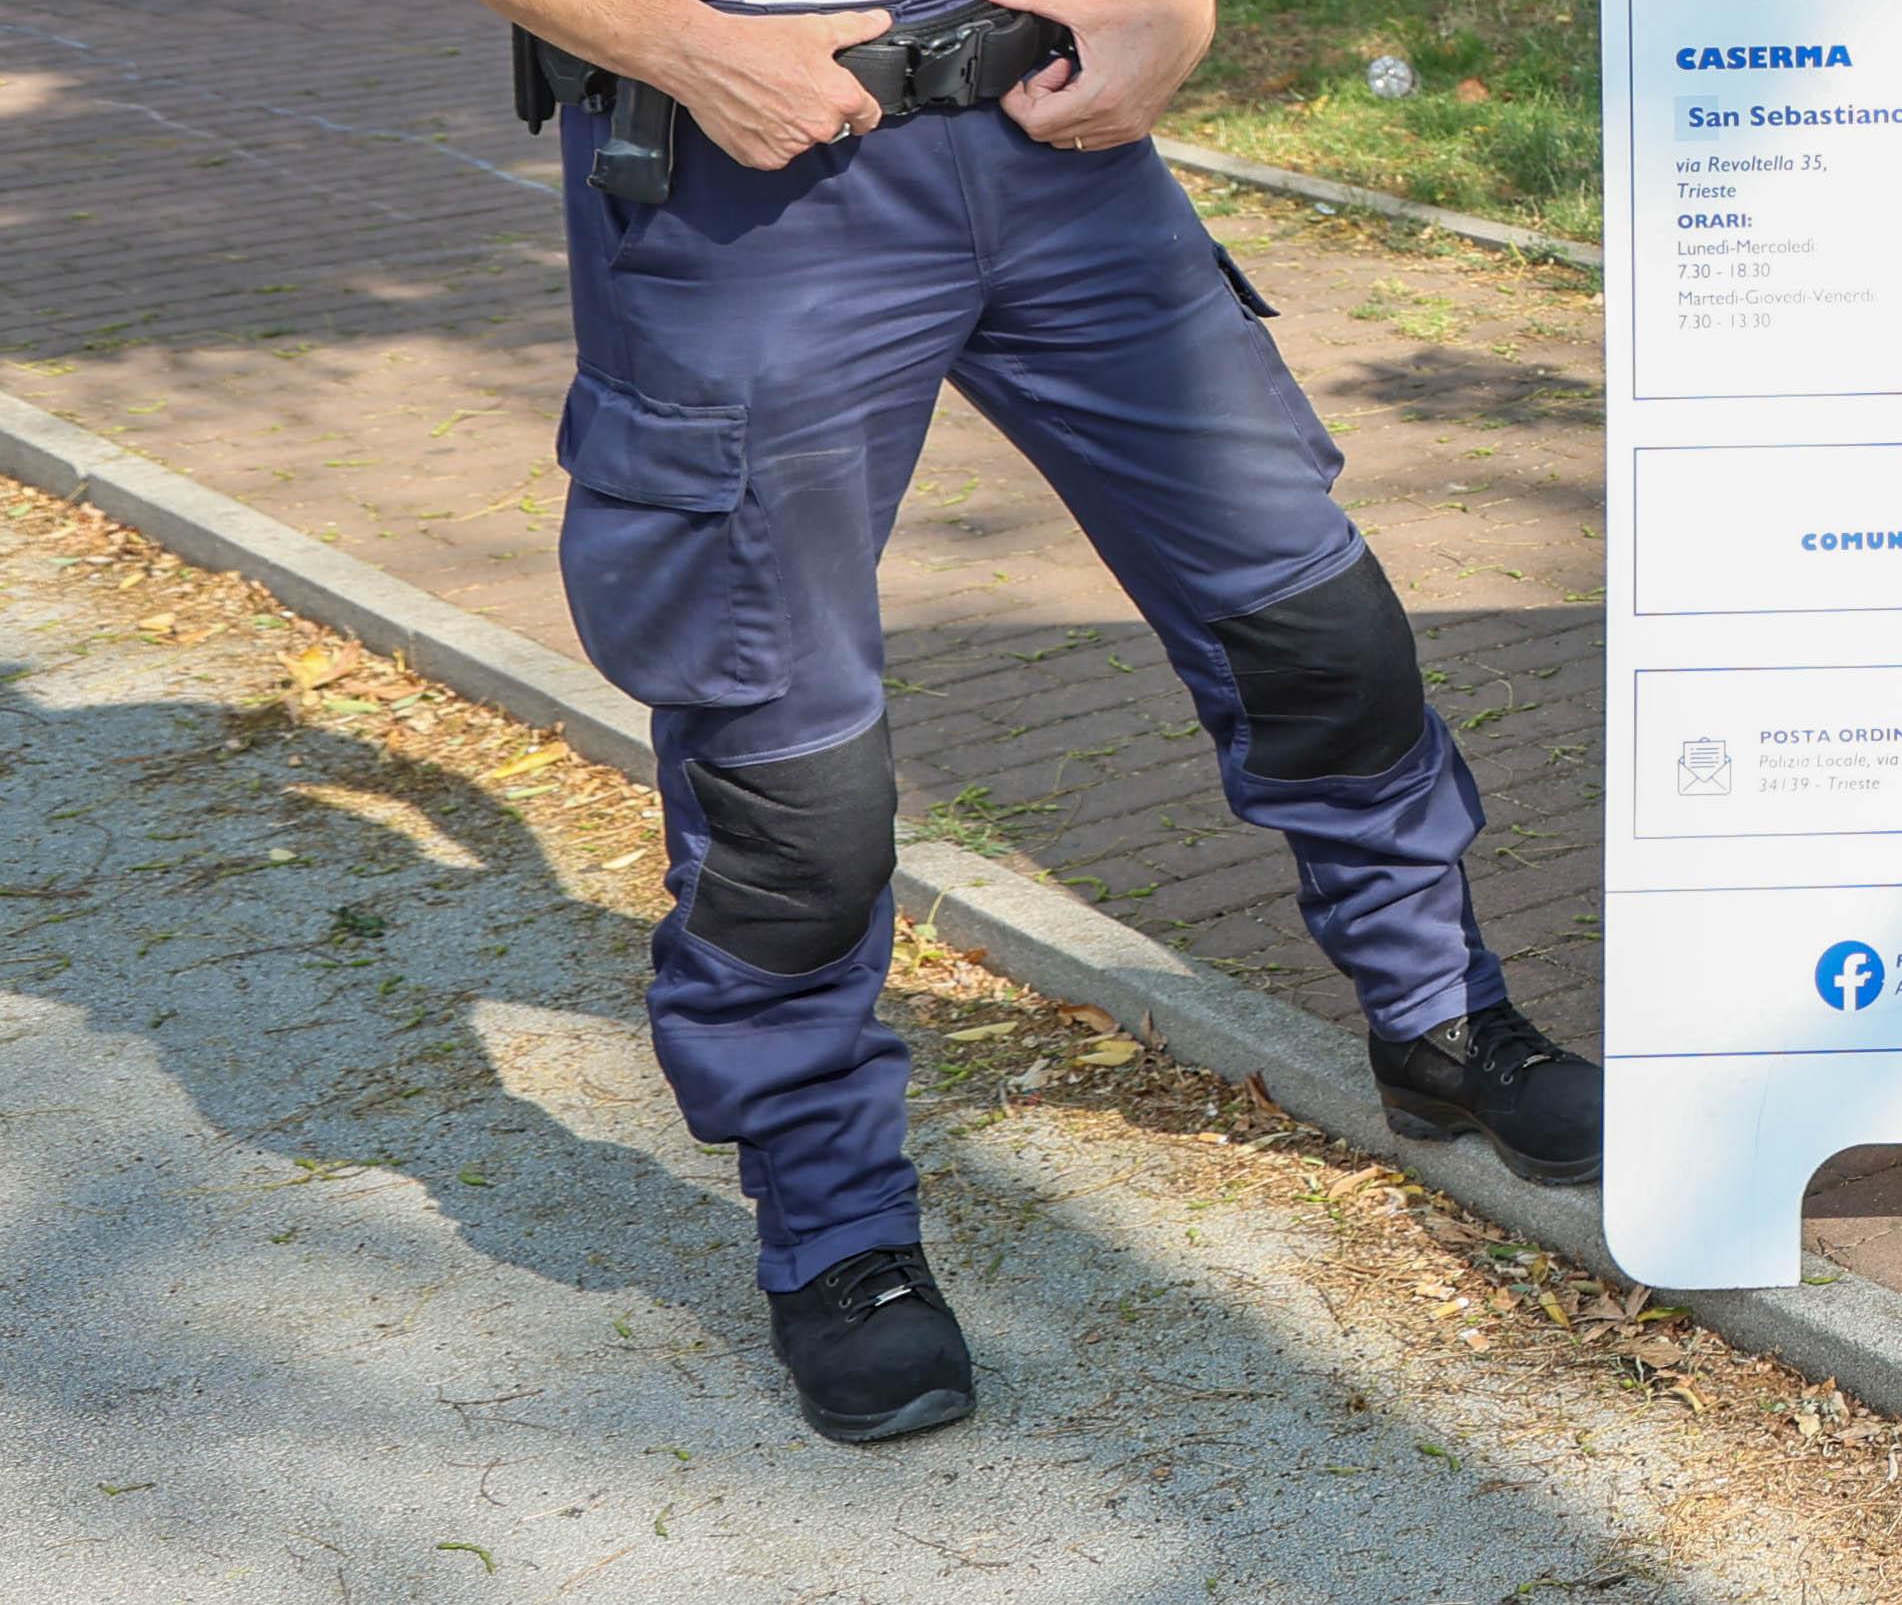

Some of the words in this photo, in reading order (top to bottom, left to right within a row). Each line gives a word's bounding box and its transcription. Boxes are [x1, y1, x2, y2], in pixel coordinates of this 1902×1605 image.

[1676, 46, 1852, 70] CASERMA
[1689, 107, 1739, 127] San
[1676, 158, 1700, 172] via
[1708, 155, 1793, 172] Revoltella
[1801, 155, 1827, 172] 35,
[1677, 183, 1736, 198] Trieste
[1678, 214, 1752, 228] ORARI:
[1678, 264, 1710, 278] 7.30
[1731, 263, 1770, 278] 18.30
[1678, 315, 1711, 329] 7.30
[1761, 730, 1830, 745] POSTA
[1877, 753, 1898, 767] via
[1828, 777, 1880, 791] Trieste
